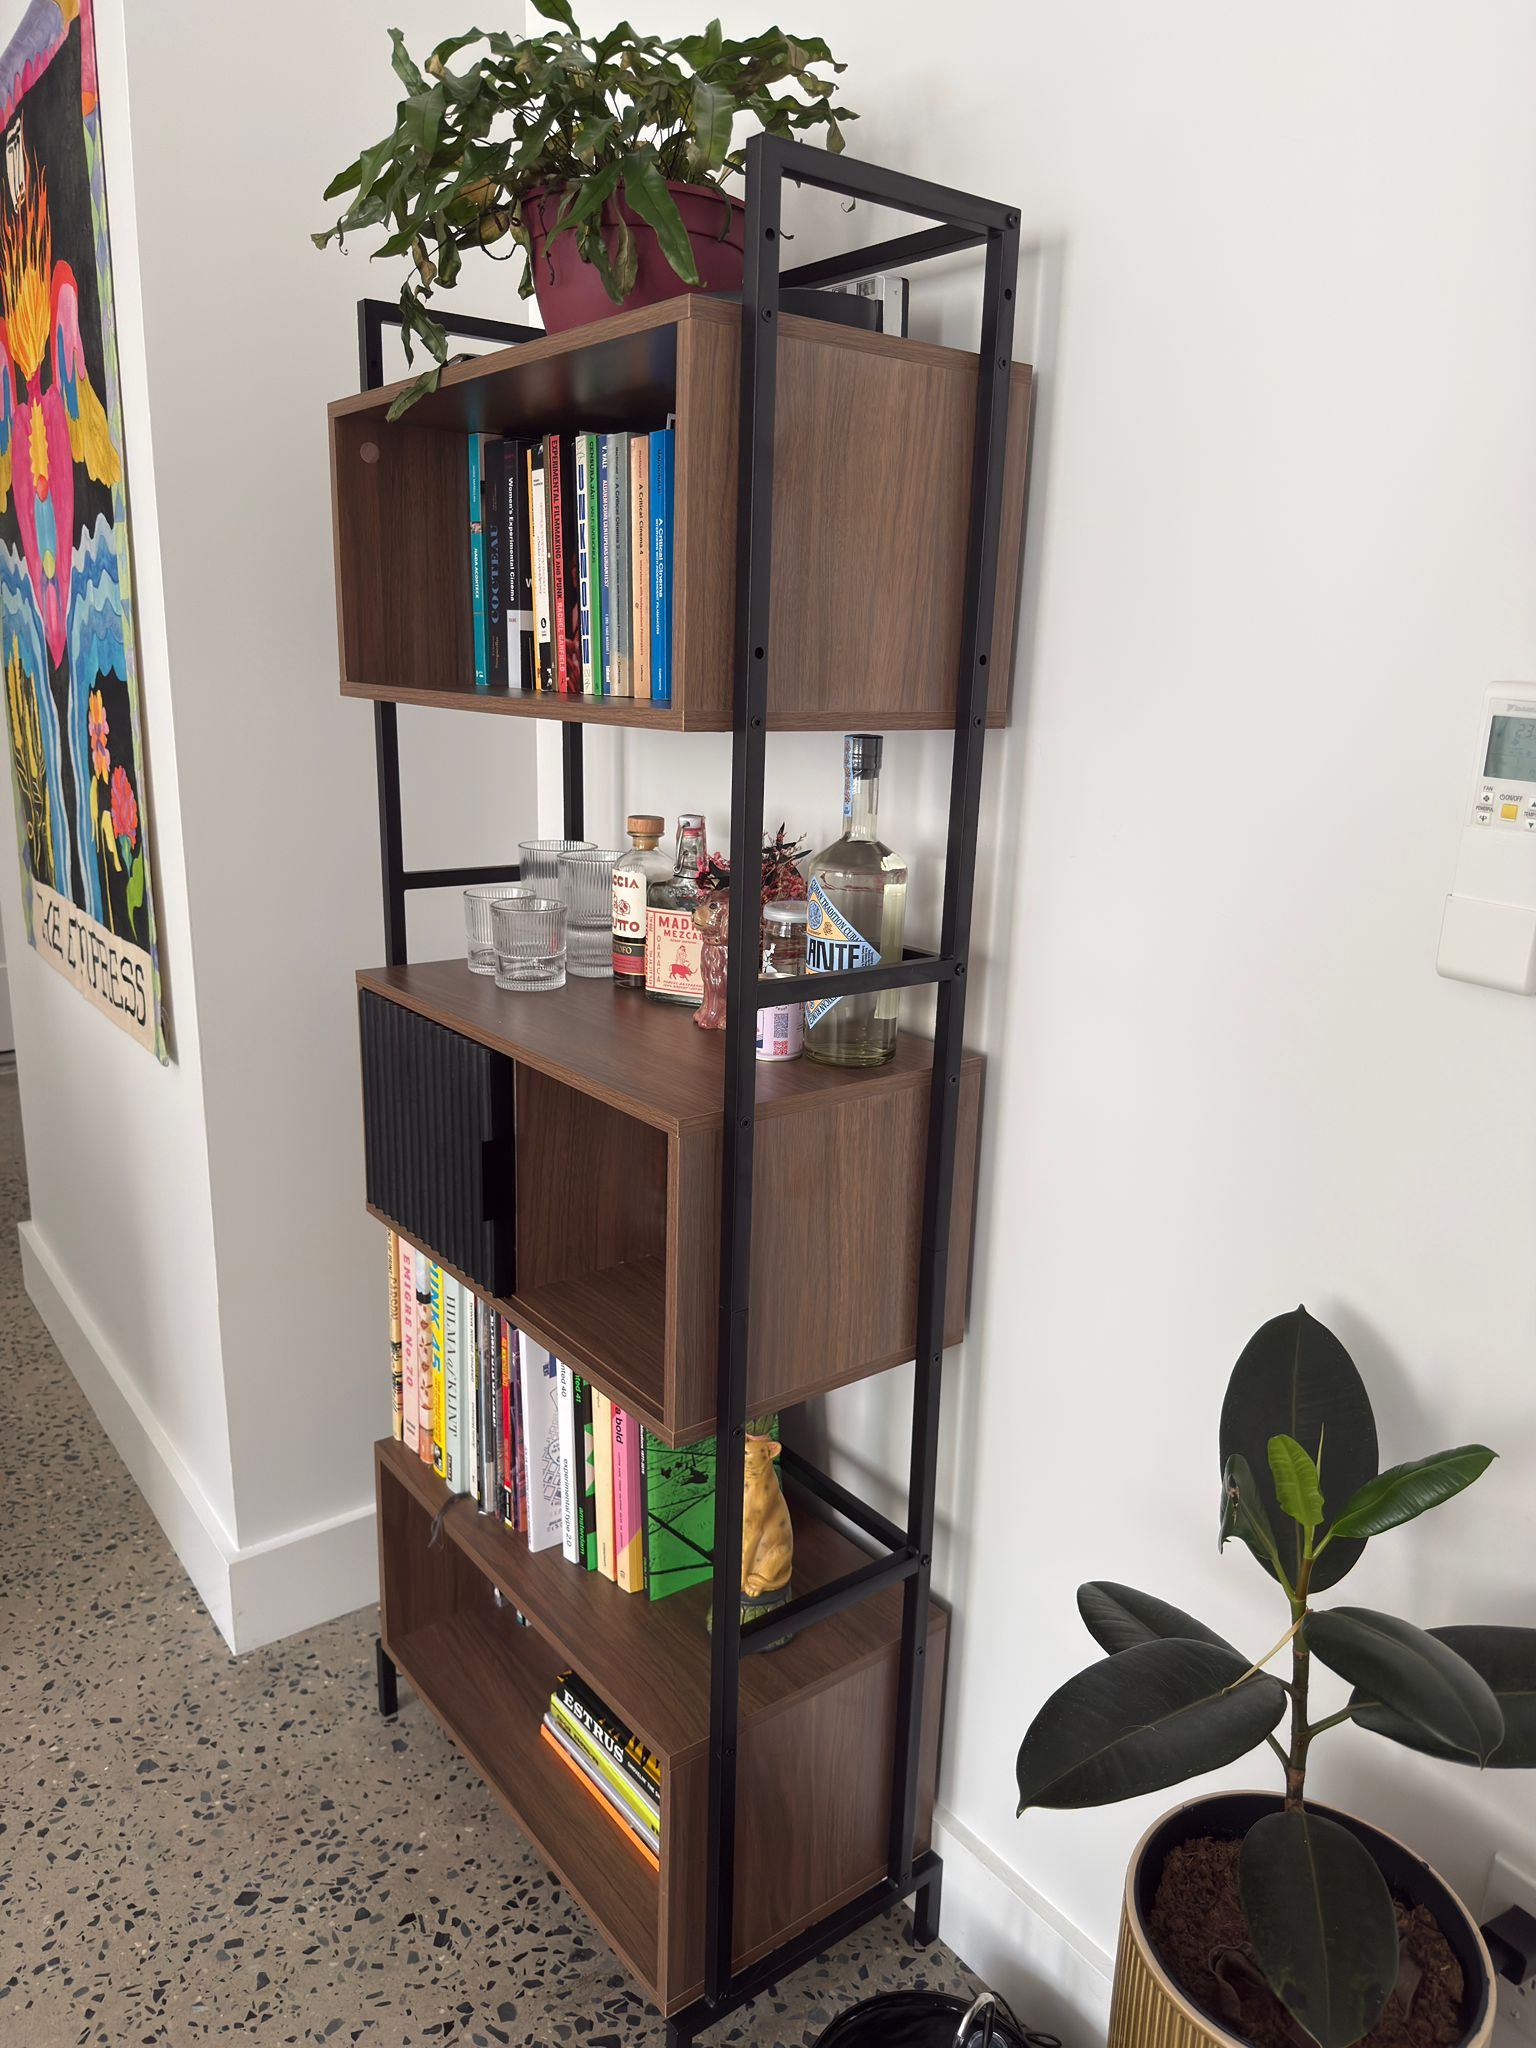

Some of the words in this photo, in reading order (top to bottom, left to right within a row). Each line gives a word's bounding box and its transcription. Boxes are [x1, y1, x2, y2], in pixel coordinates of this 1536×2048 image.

[551, 440, 560, 504] EXPERIMENTAL
[508, 516, 516, 570] Experimental
[553, 505, 561, 559] FILMMAKING
[490, 525, 500, 624] COCTEAU
[1505, 794, 1523, 802] ON/OFF
[37, 892, 65, 960] HE
[663, 929, 704, 941] MEZCAL
[821, 898, 846, 931] TRADITION
[403, 1254, 412, 1327] EMIGRE
[431, 1331, 441, 1372] 45
[446, 1295, 456, 1355] HILMA
[446, 1357, 457, 1378] af
[560, 1385, 567, 1397] 40
[447, 1379, 458, 1437] KLINT
[575, 1393, 582, 1403] 41
[615, 1417, 624, 1445] bold
[563, 1458, 571, 1513] experimental
[564, 1513, 572, 1532] type
[562, 1689, 624, 1764] ESTRUS
